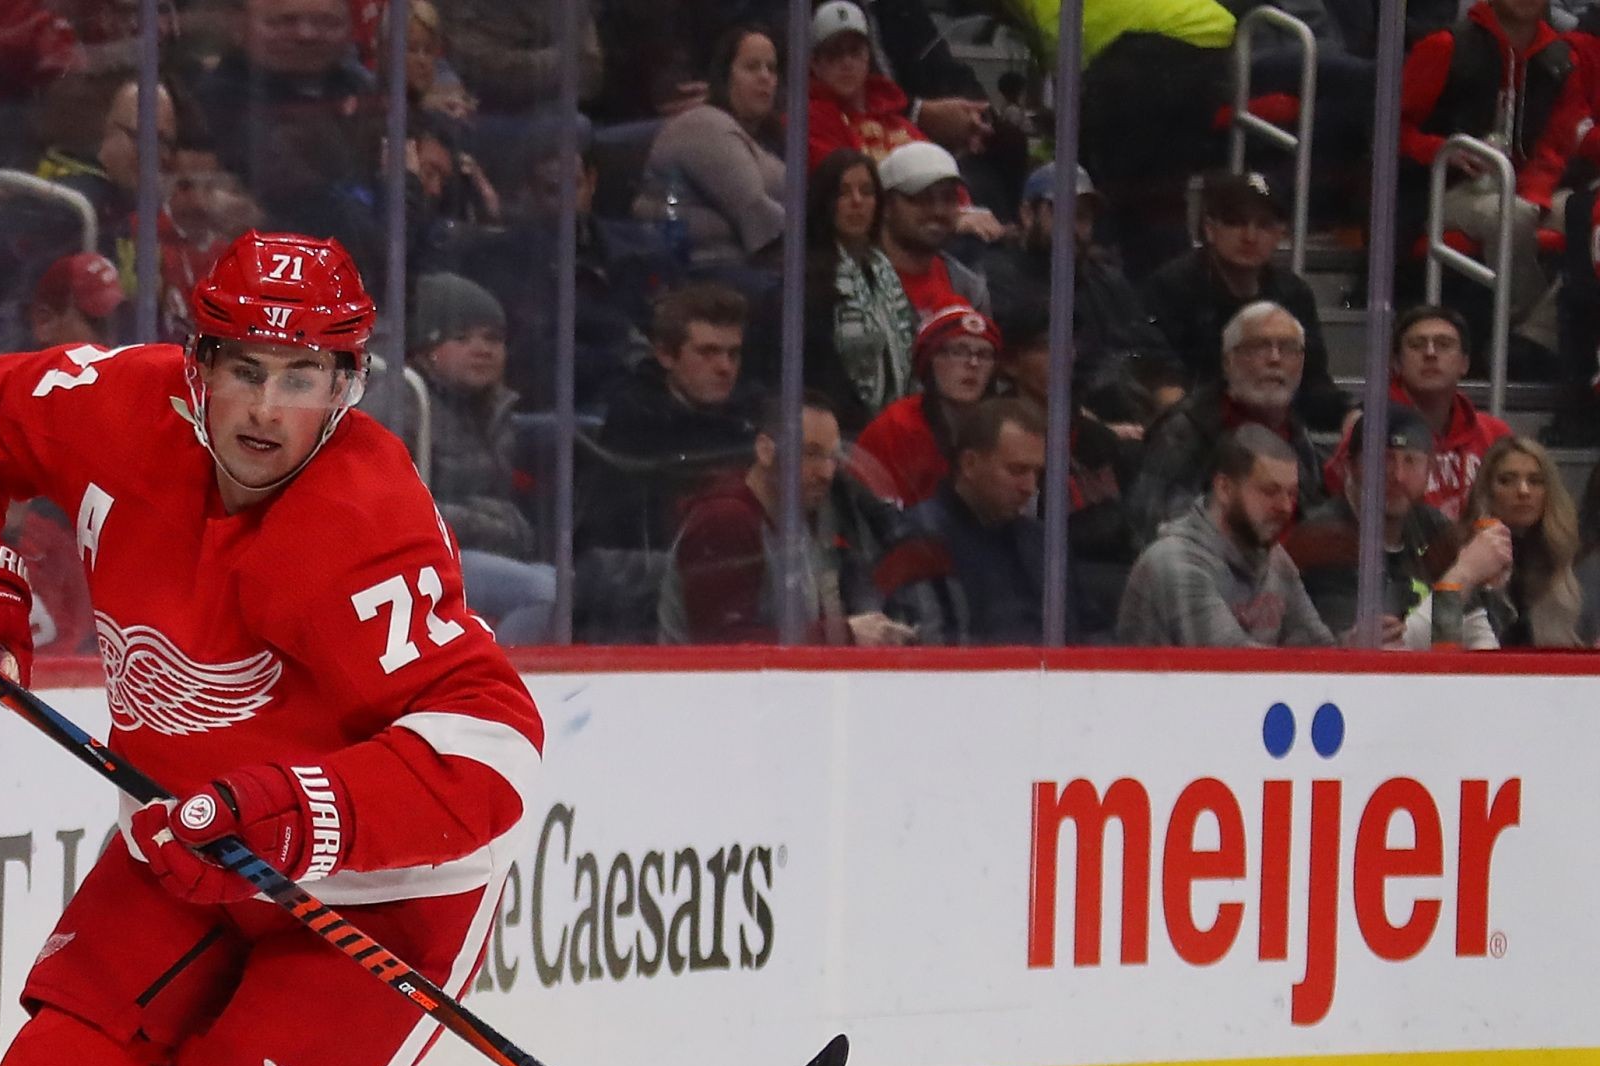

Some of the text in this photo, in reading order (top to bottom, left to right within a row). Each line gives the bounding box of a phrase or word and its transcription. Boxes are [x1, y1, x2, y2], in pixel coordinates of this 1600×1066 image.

[269, 254, 304, 280] 71
[77, 482, 115, 573] A
[350, 566, 466, 676] 71
[279, 826, 292, 863] COVERT
[290, 766, 342, 884] WARR
[1026, 702, 1522, 1027] meijer
[531, 802, 775, 989] Caesars
